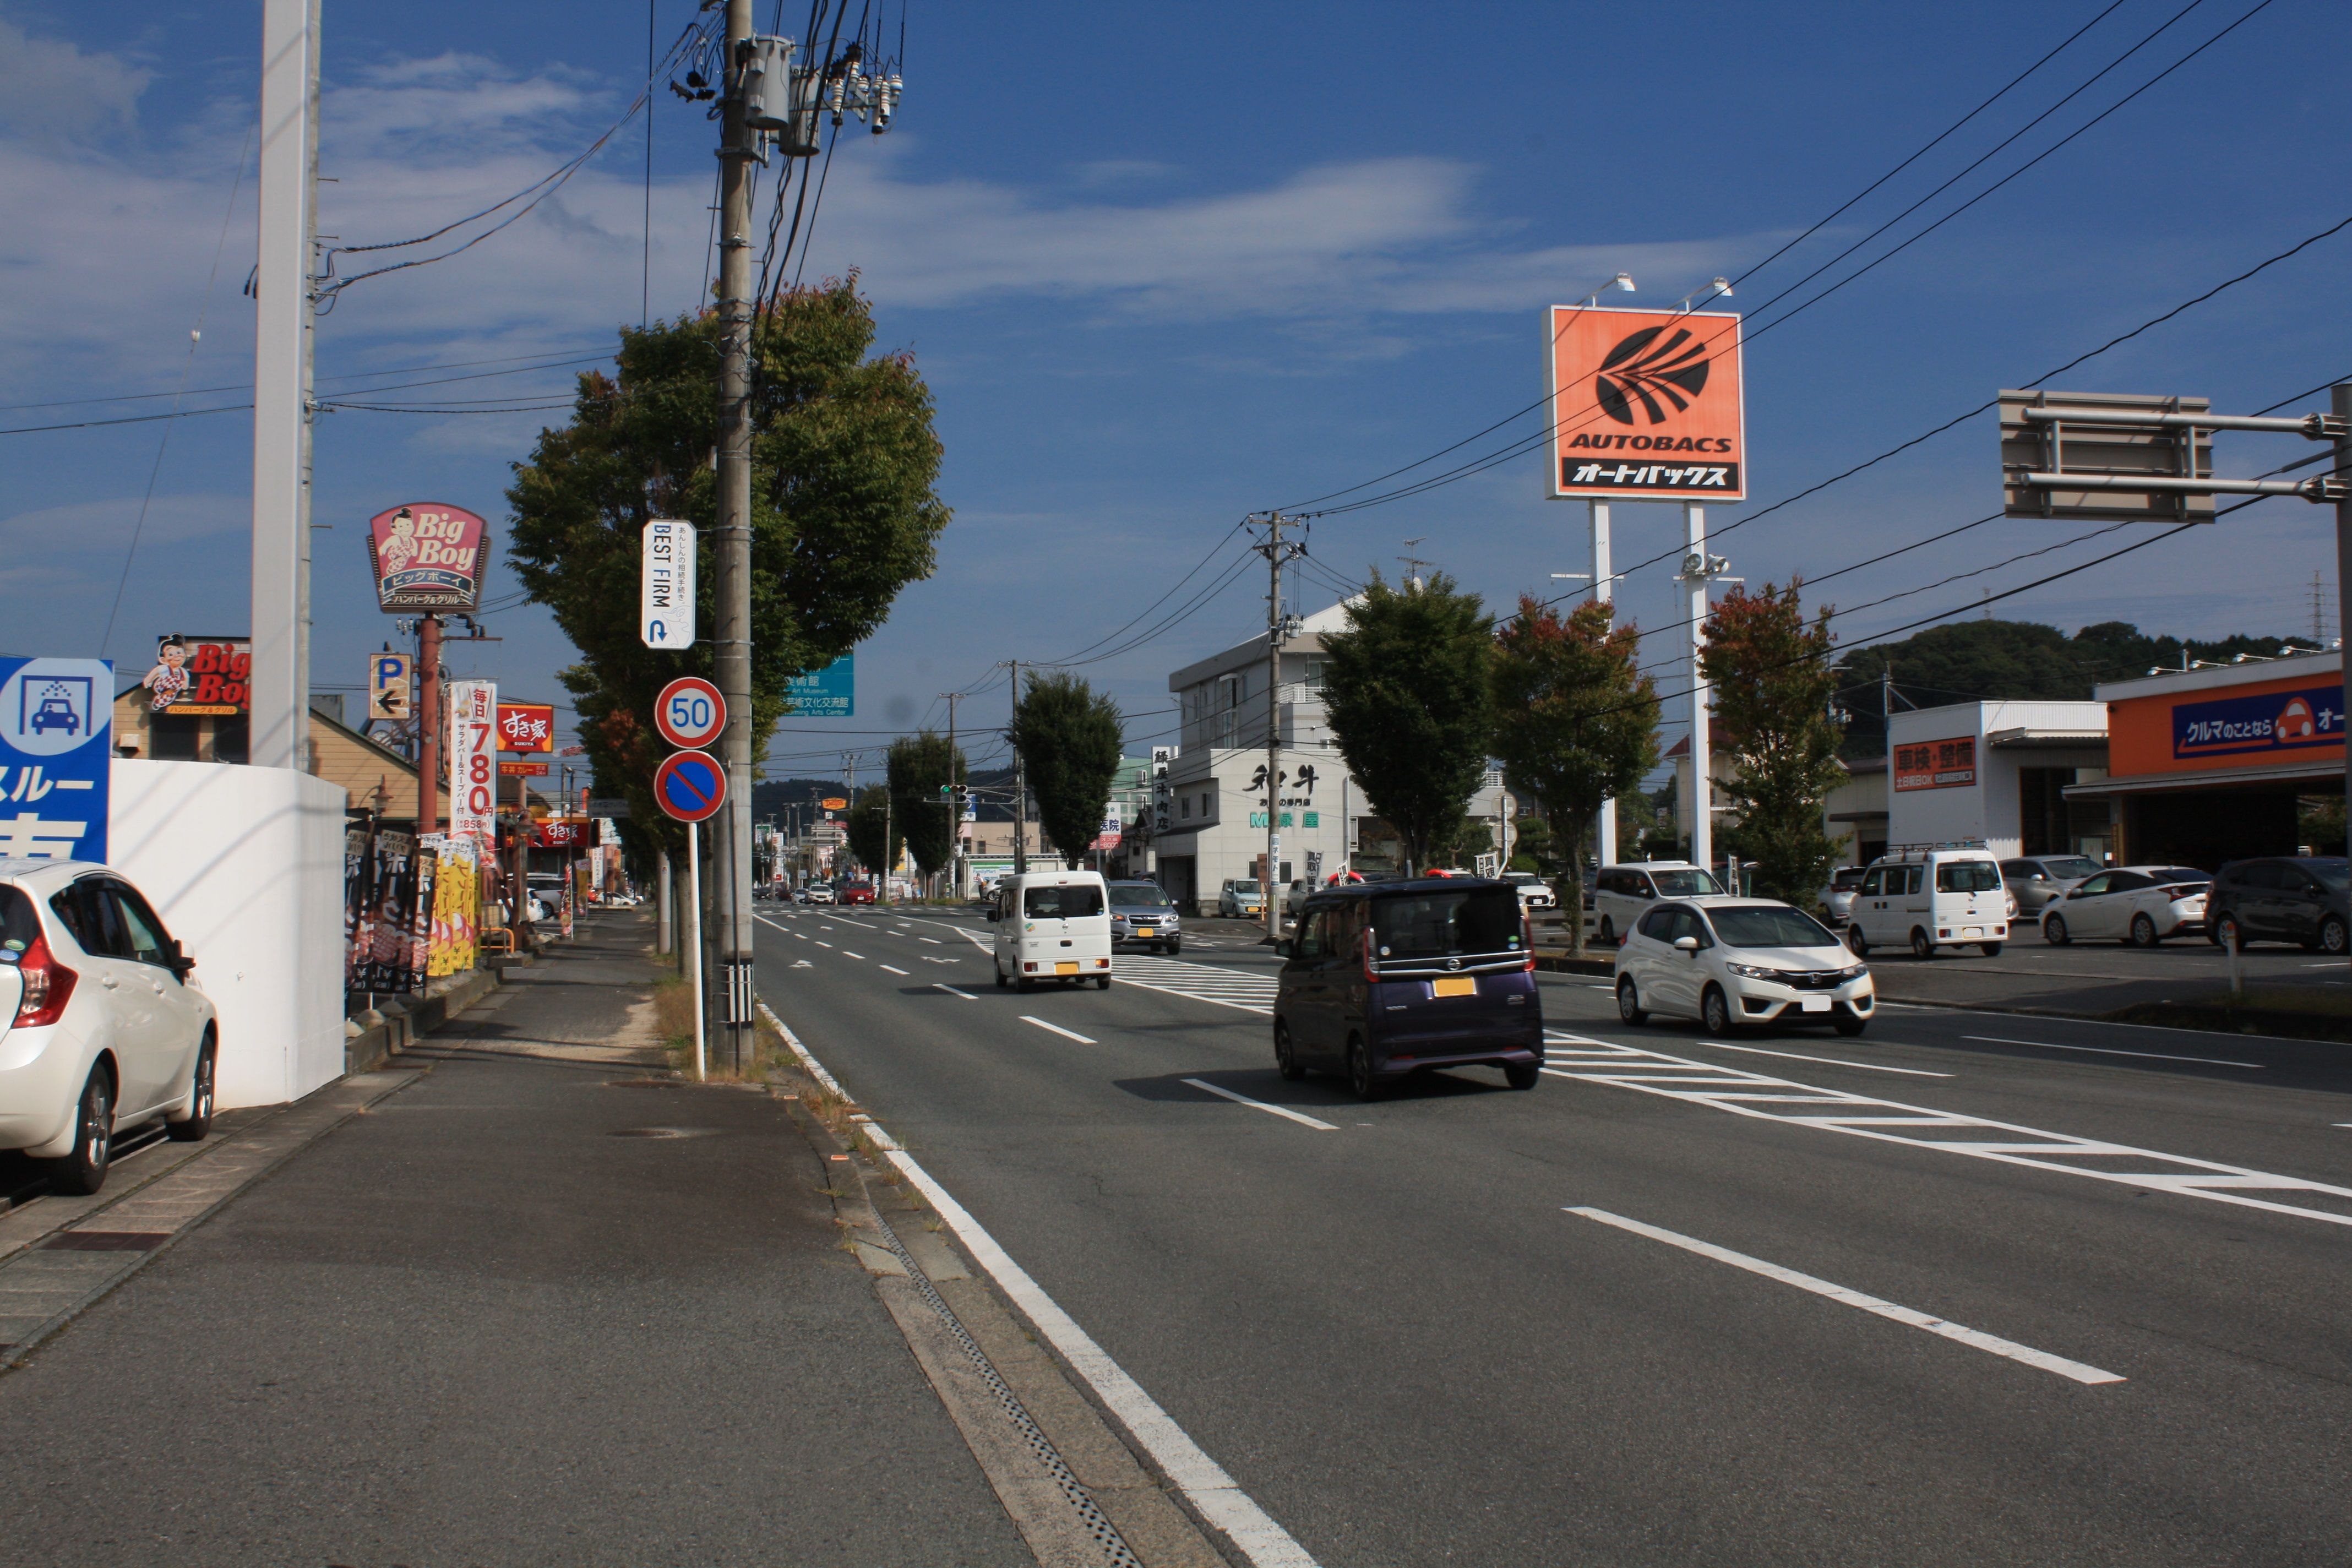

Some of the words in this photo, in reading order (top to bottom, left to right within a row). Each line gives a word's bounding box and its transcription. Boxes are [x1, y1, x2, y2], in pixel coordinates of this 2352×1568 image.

[1568, 434, 1732, 453] AUTOBACS
[1572, 464, 1728, 486] オートバックス
[415, 513, 466, 545] Big
[654, 525, 672, 563] BEST
[416, 540, 476, 571] Boy
[393, 571, 462, 586] ビッグボーイ
[653, 569, 671, 608] FIRM
[190, 643, 252, 680] Big
[379, 658, 402, 689] P
[473, 689, 487, 718] 毎日
[672, 698, 710, 728] 50
[503, 710, 547, 742] すき家
[2187, 719, 2272, 743] クルマのことなら
[1259, 798, 1311, 808] おの専門店
